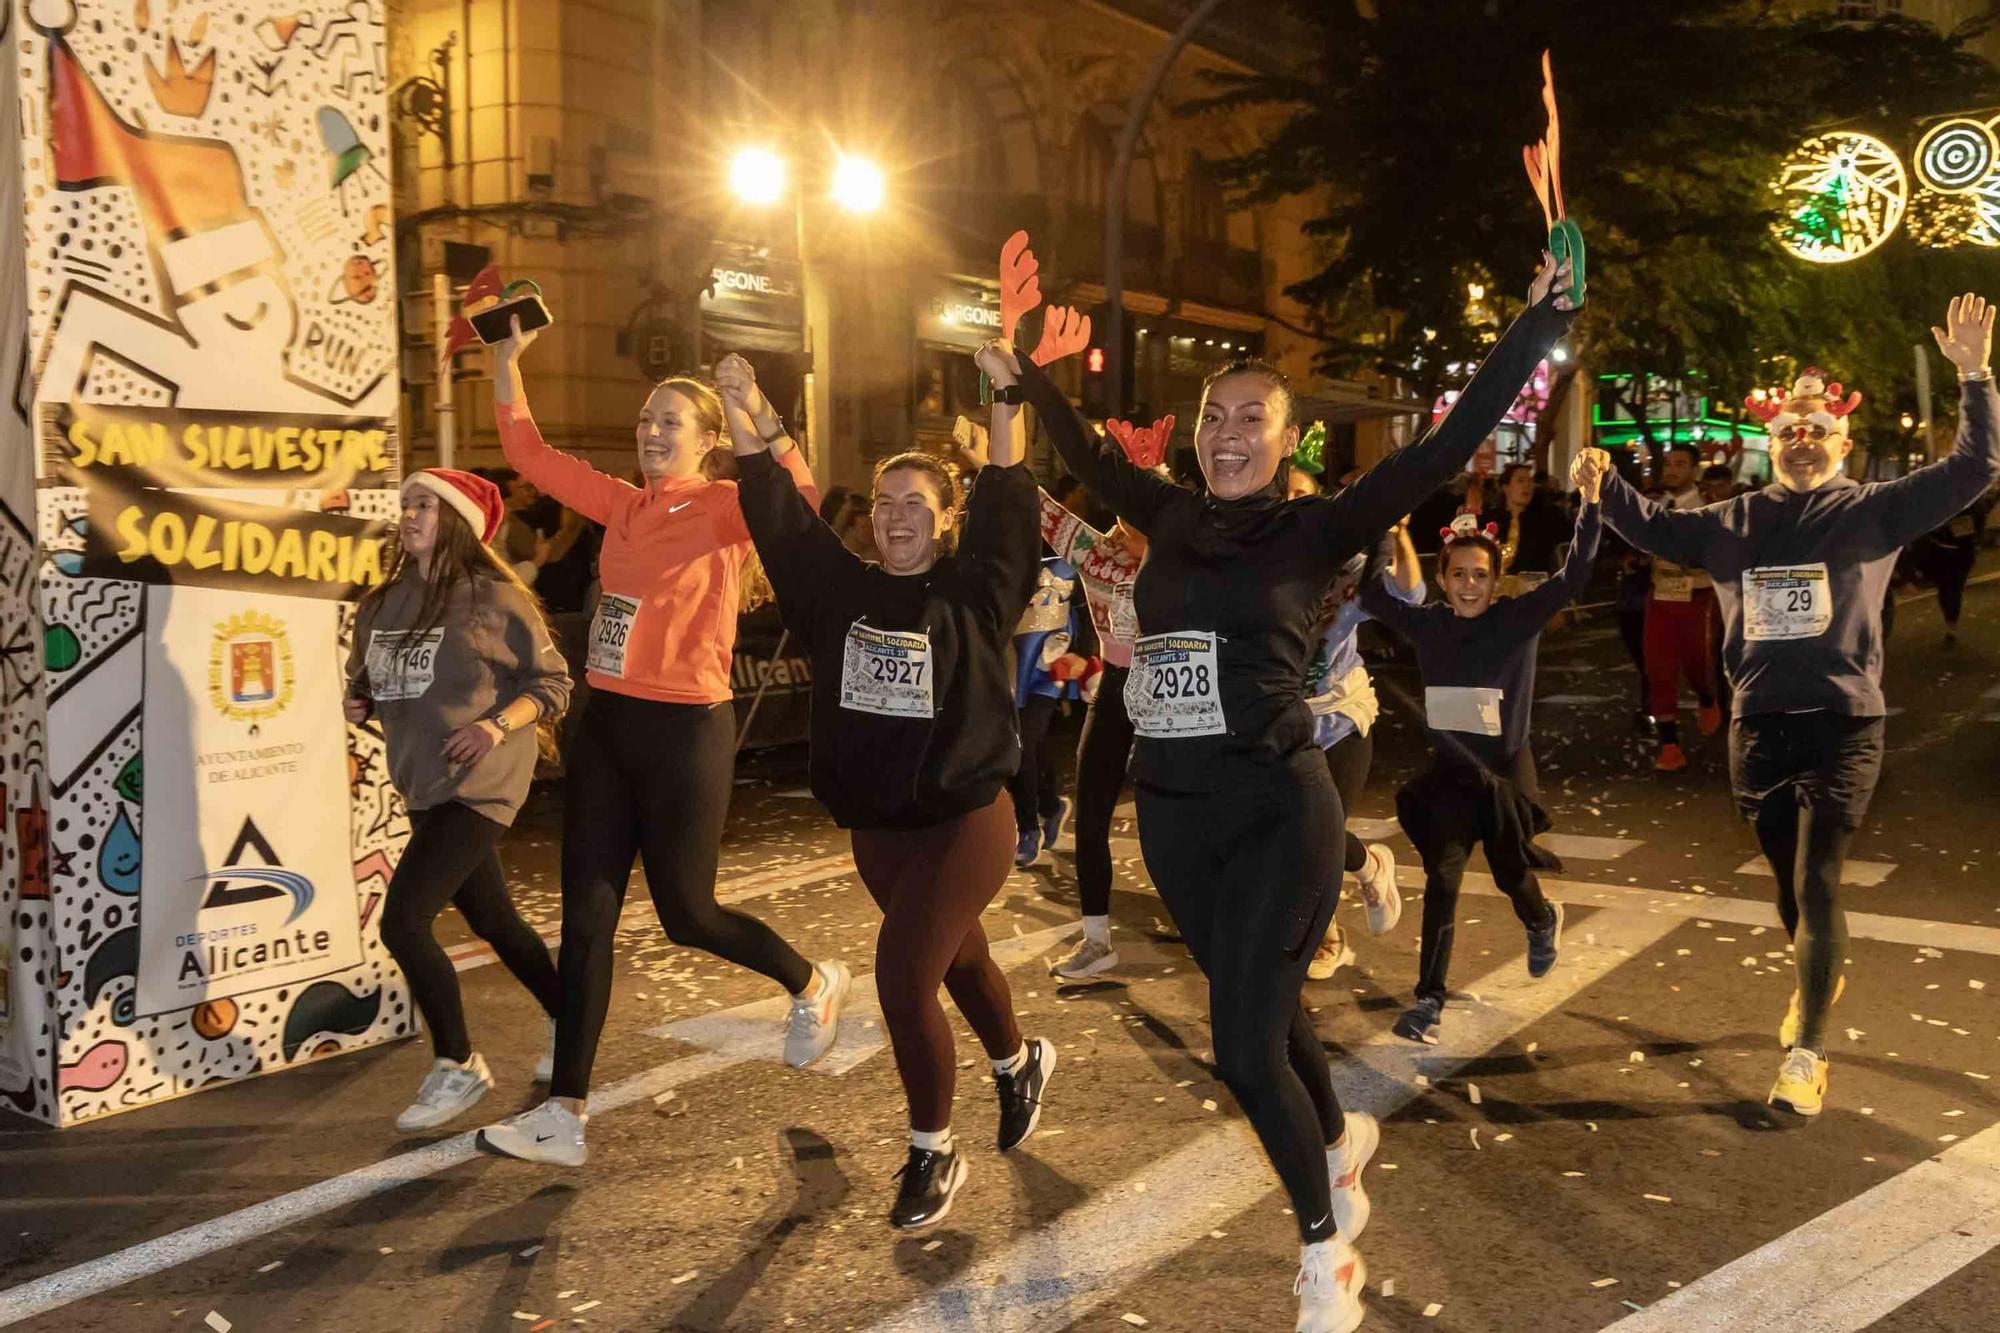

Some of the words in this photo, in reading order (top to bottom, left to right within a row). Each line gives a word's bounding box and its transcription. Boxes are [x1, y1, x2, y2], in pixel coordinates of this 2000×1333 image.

[68, 421, 168, 468] SAN
[182, 423, 392, 473] SILVESTRE
[115, 505, 386, 586] SOLIDARIA
[1786, 589, 1812, 612] 29
[598, 618, 629, 647] 2926
[886, 636, 925, 650] SOLIDARIA
[1168, 639, 1209, 650] SOLIDARIA
[871, 656, 925, 686] 2927
[1152, 664, 1211, 699] 2928
[194, 742, 305, 767] AYUNTAMIENTO
[208, 770, 232, 784] DE
[233, 760, 299, 781] ALICANTE
[175, 923, 258, 948] DEPORTES
[178, 929, 330, 982] Alicante
